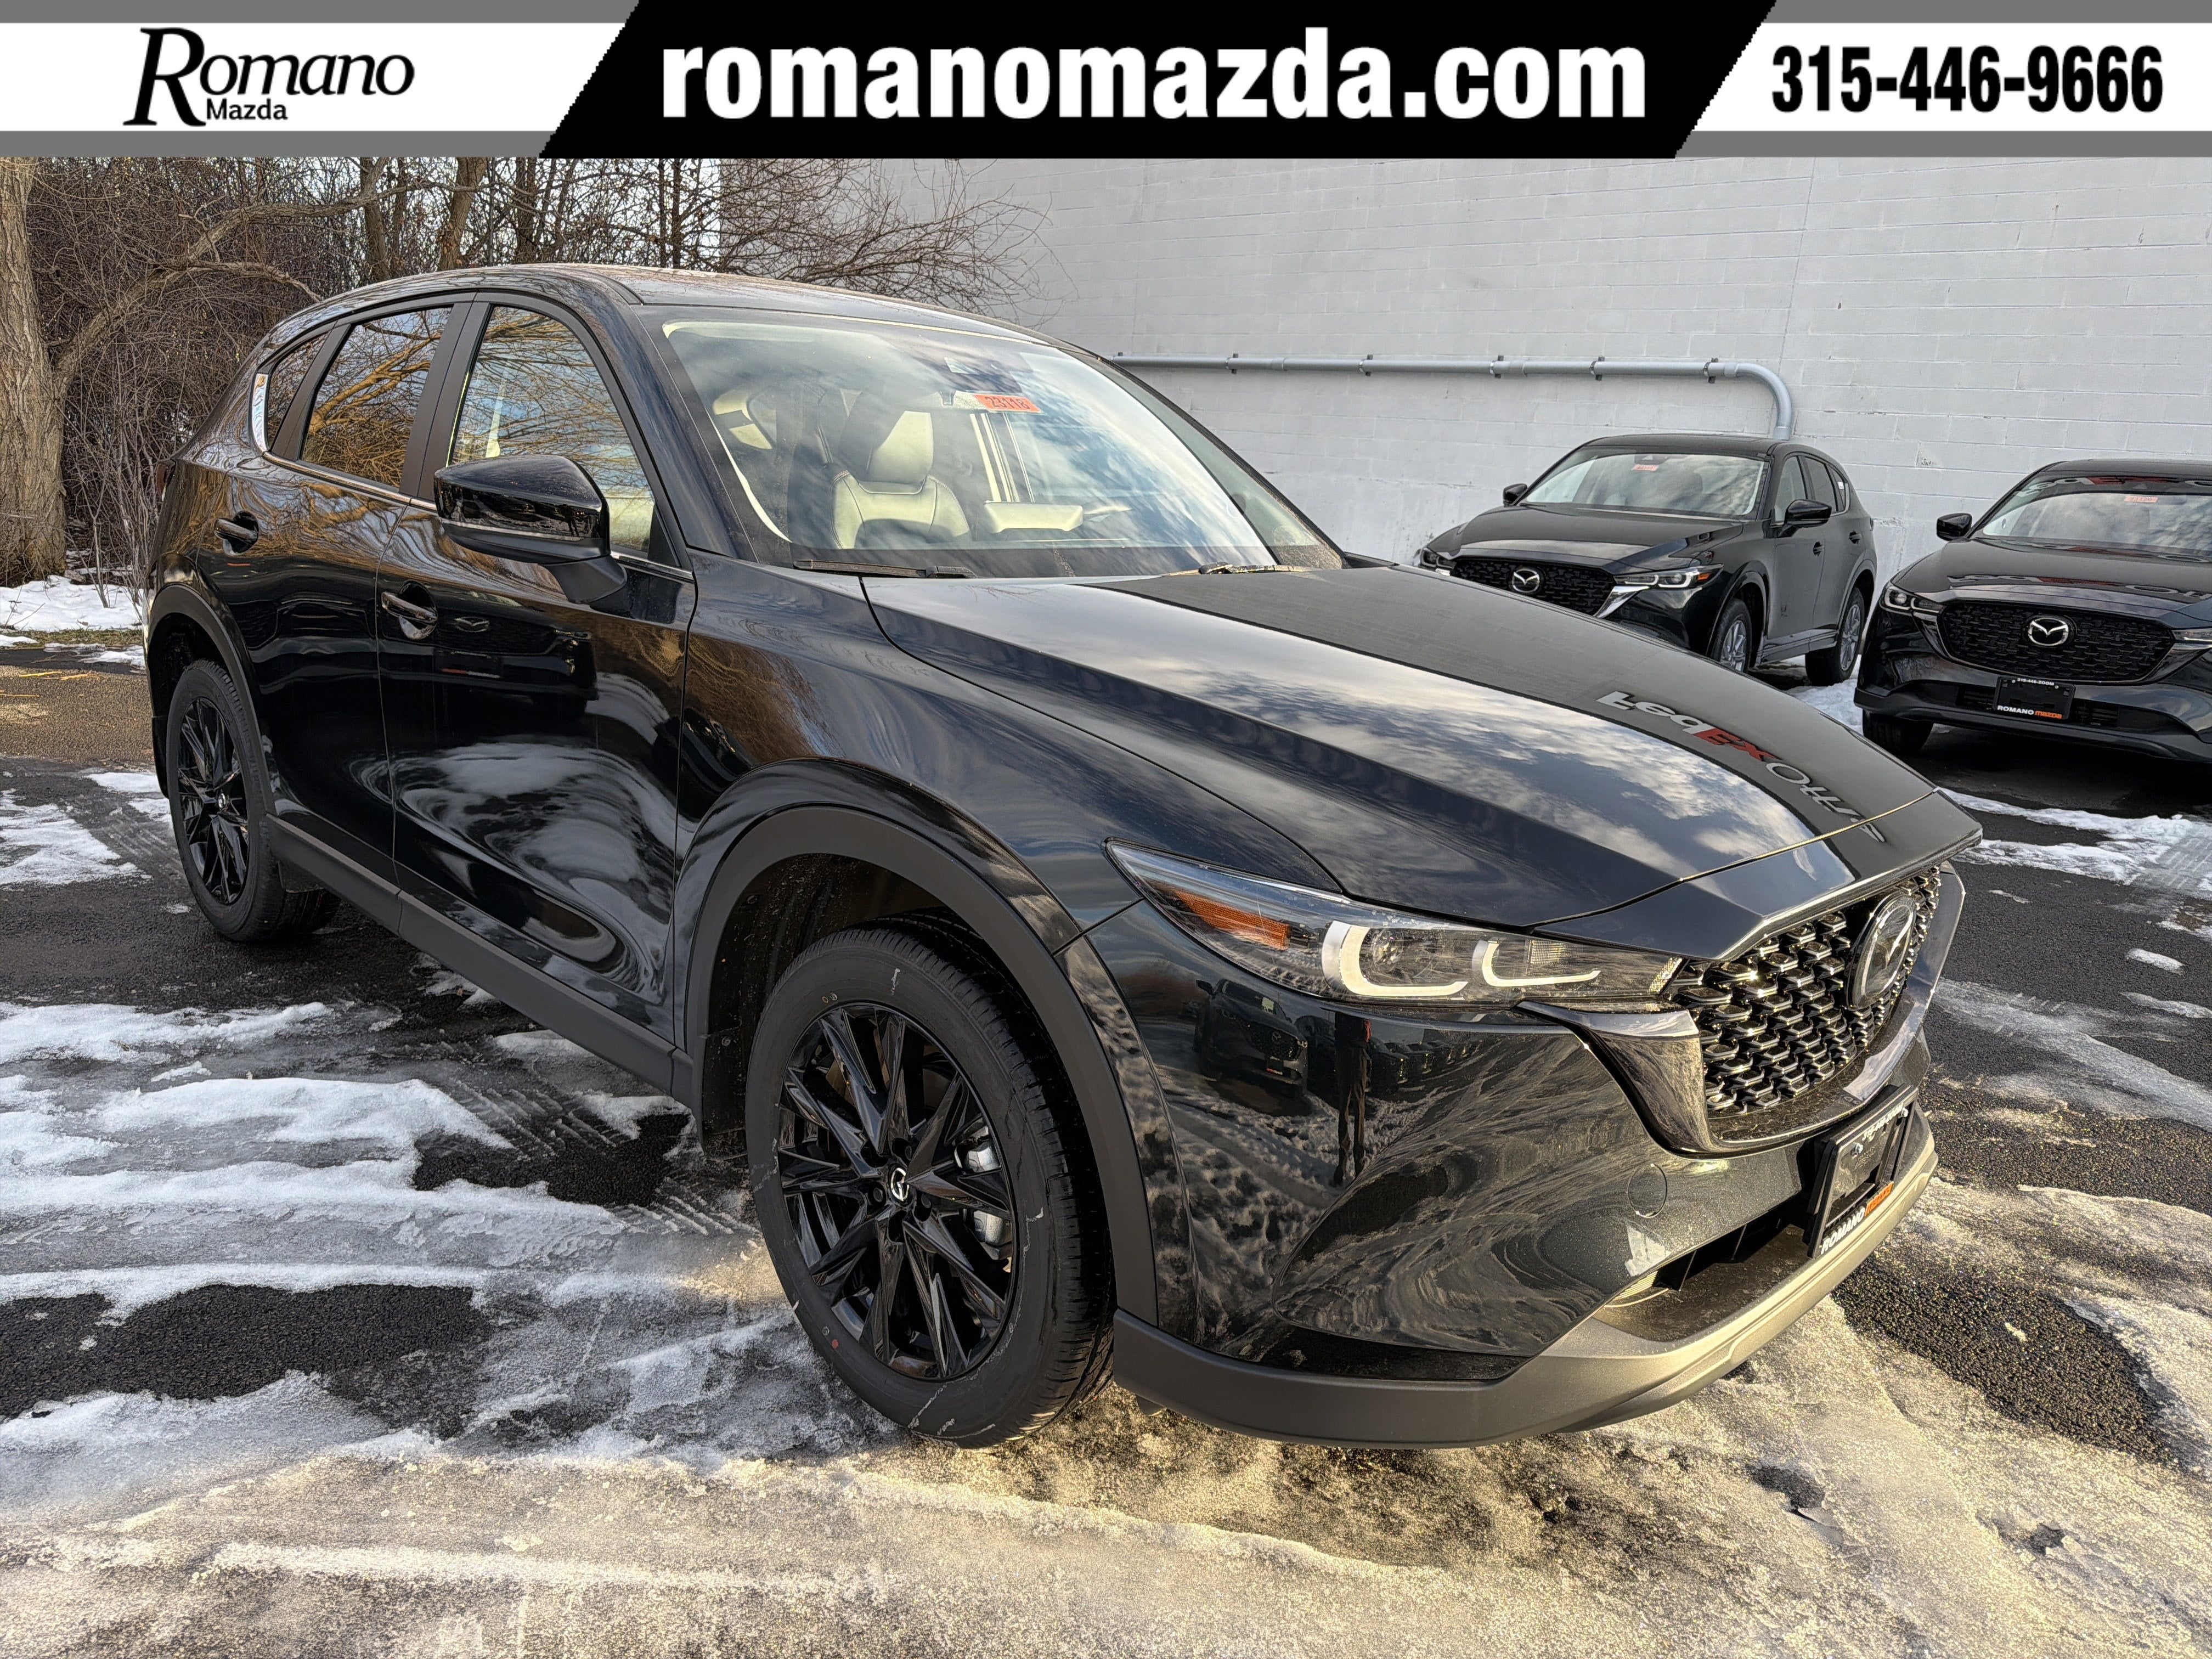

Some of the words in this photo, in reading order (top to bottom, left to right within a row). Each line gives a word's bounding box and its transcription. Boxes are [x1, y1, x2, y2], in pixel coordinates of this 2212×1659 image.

[985, 396, 1030, 410] 23118
[1997, 705, 2034, 715] ROMANO
[1820, 1207, 1865, 1255] ROMANO
